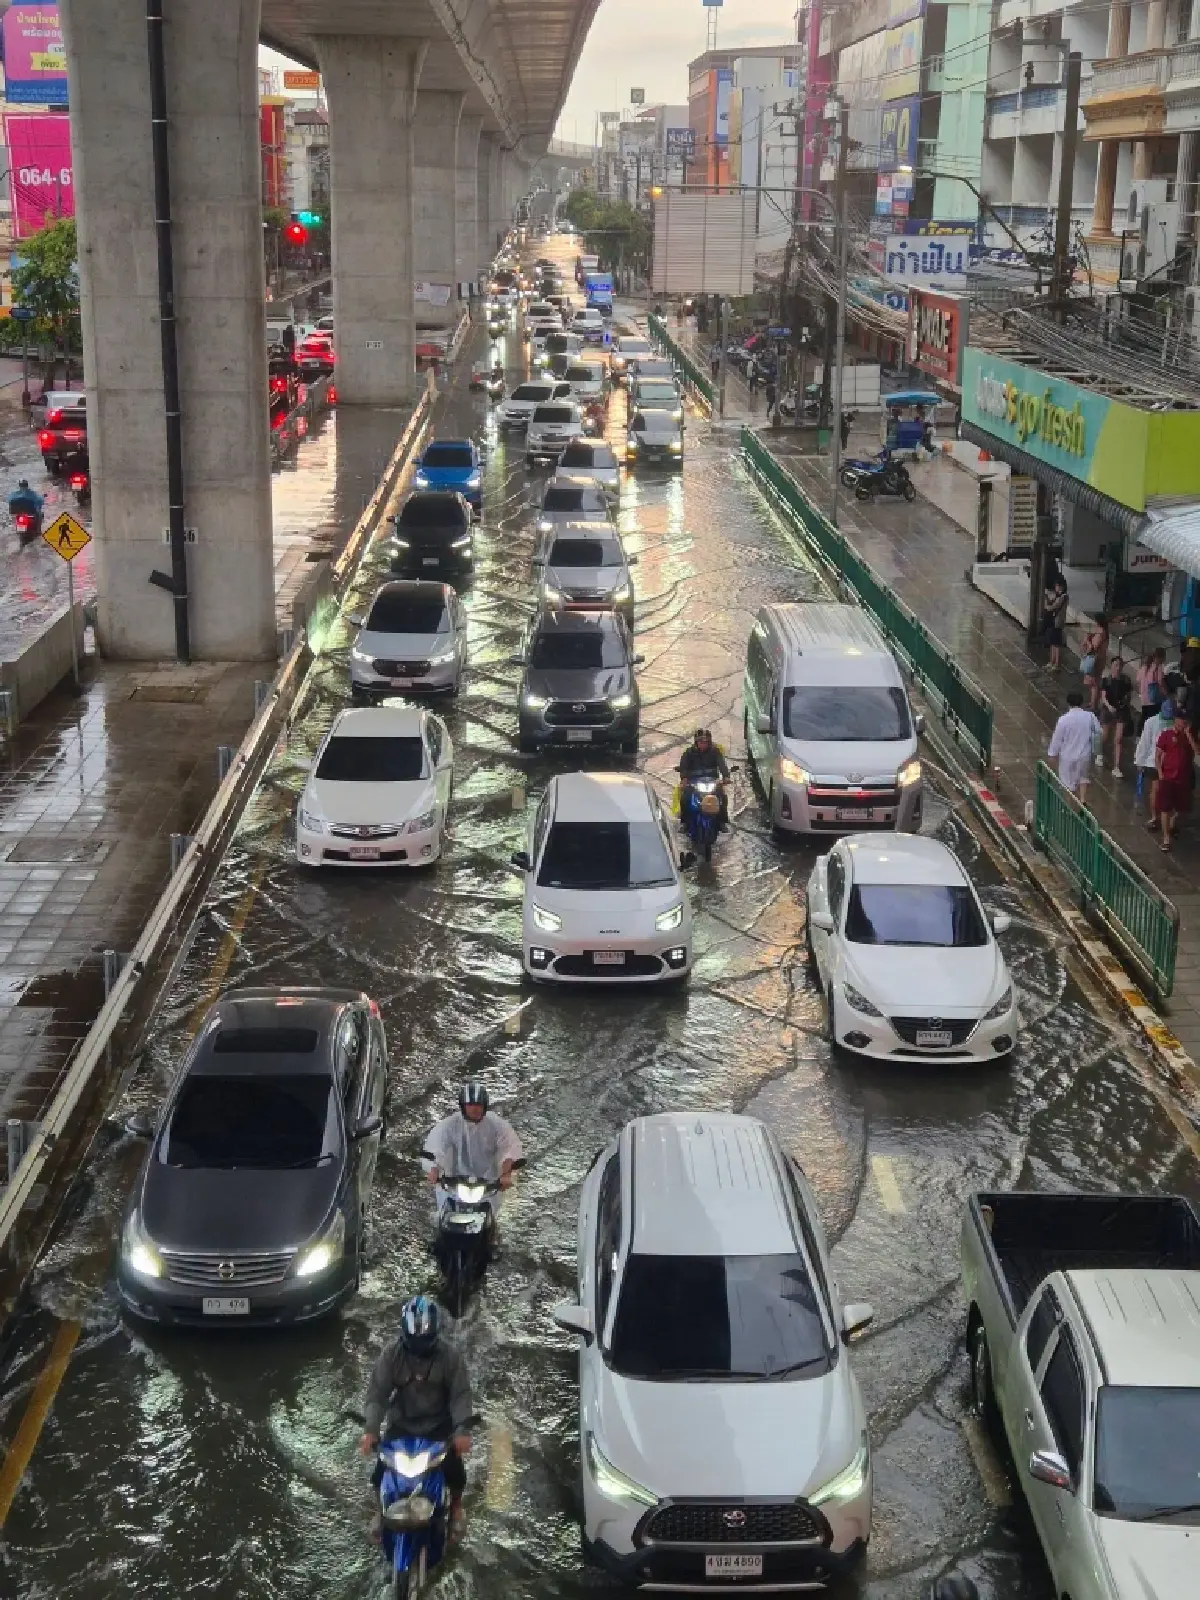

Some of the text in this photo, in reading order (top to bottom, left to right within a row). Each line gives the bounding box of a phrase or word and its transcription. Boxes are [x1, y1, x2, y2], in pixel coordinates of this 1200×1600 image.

[20, 167, 73, 186] 064-6
[886, 241, 963, 274] ทำฟัน
[1016, 391, 1040, 443] go
[1041, 386, 1085, 457] fresh
